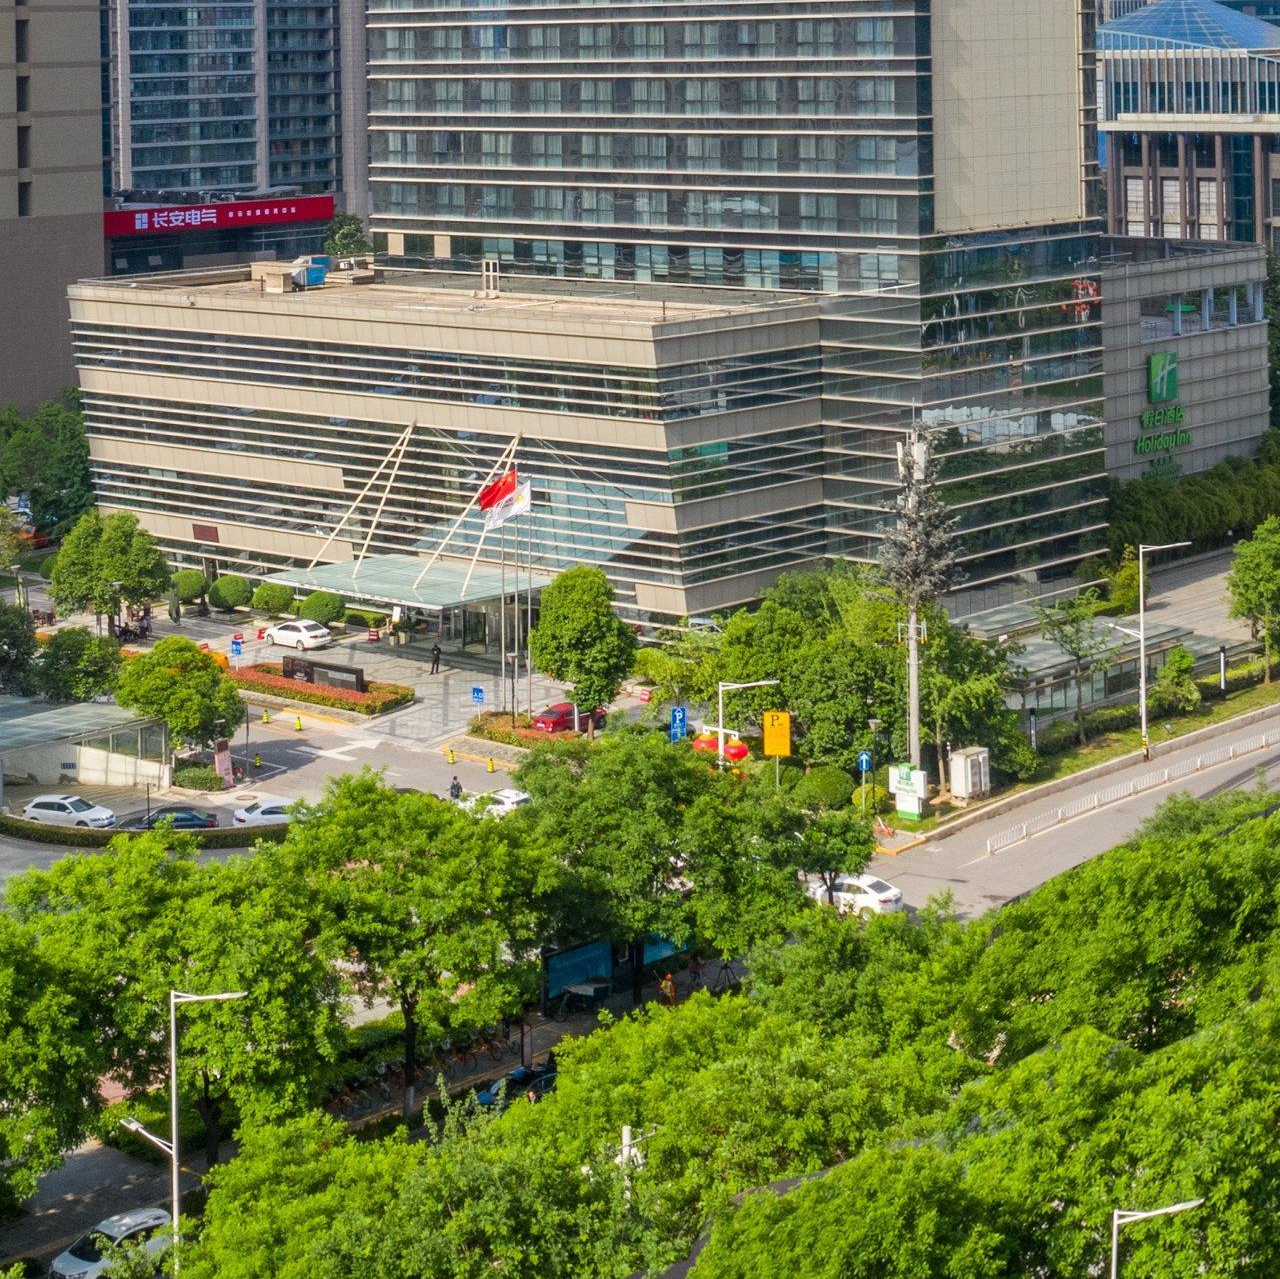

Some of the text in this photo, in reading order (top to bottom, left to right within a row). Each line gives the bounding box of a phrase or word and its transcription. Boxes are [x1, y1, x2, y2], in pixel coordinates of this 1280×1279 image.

[152, 209, 217, 228] 长安电气
[1141, 404, 1185, 429] 假日酒店
[1136, 428, 1192, 454] Holiday Inn
[770, 714, 780, 727] P
